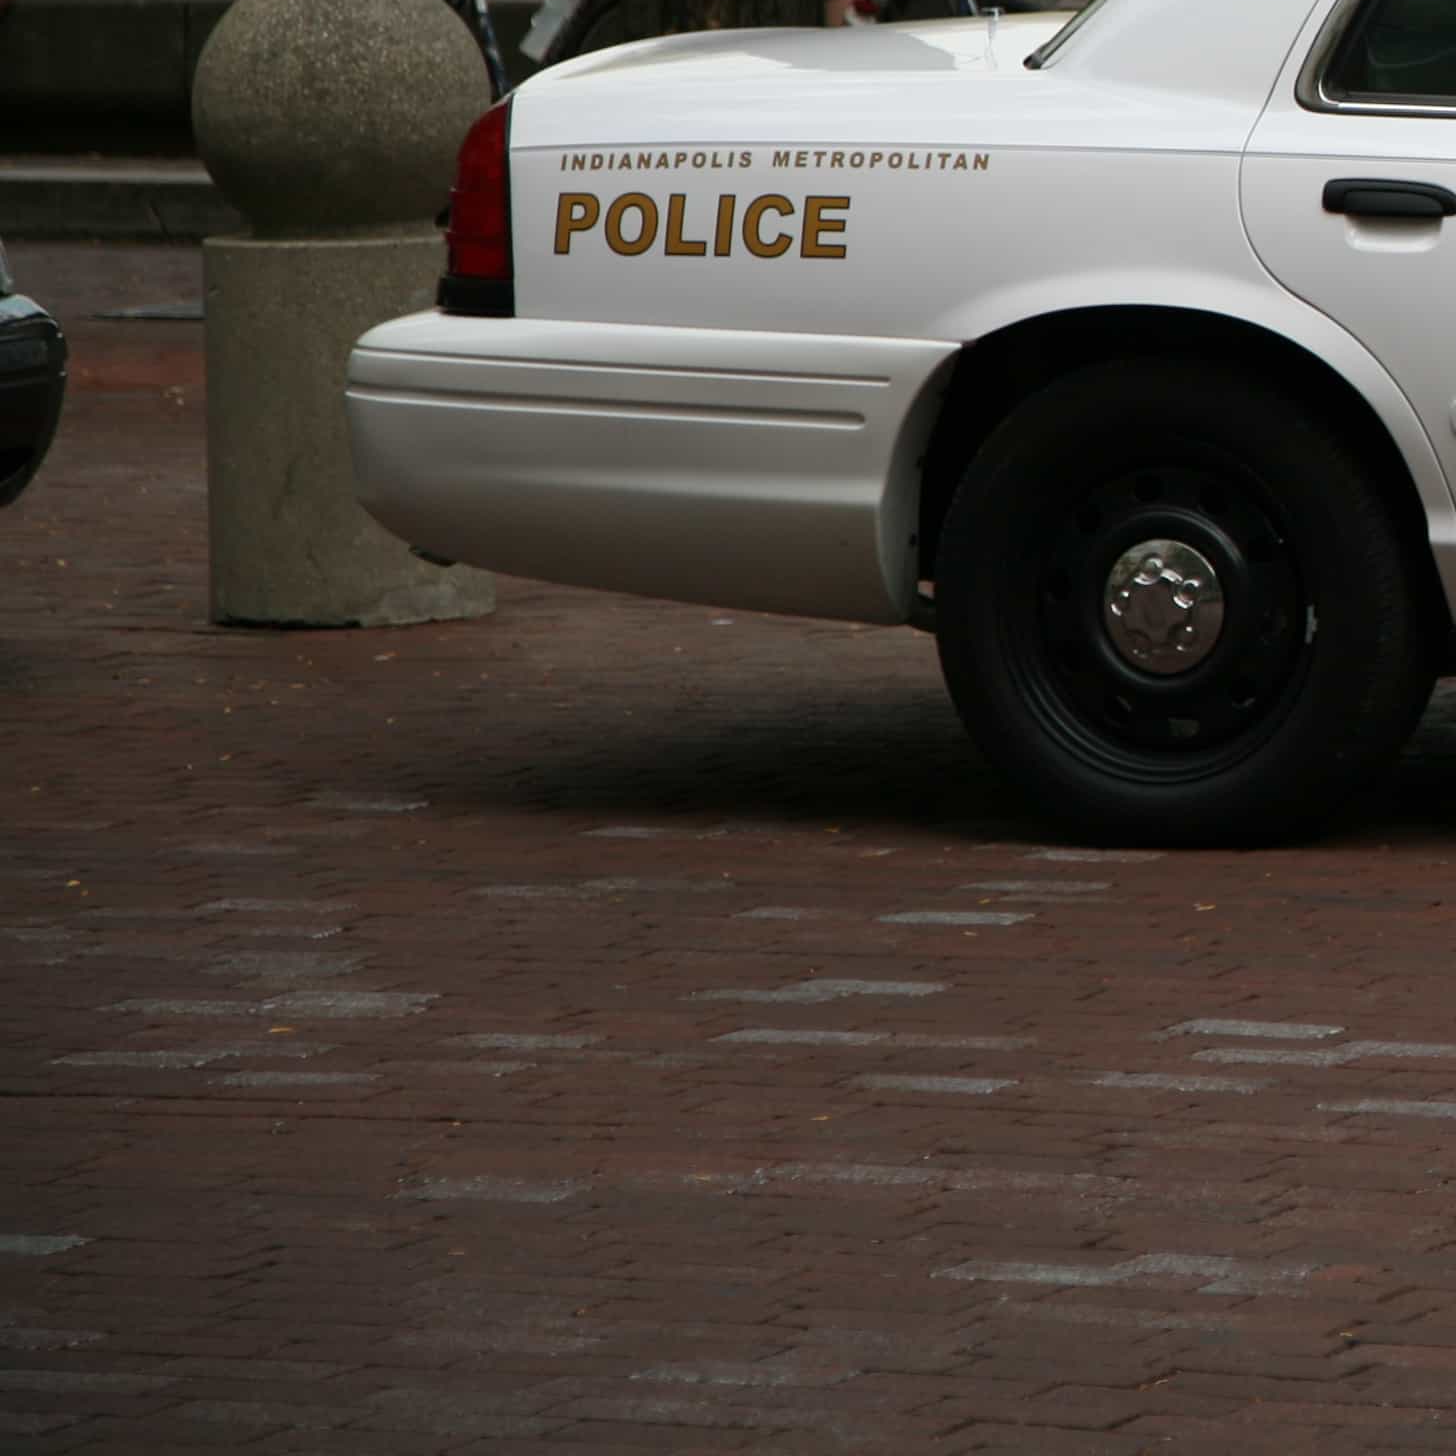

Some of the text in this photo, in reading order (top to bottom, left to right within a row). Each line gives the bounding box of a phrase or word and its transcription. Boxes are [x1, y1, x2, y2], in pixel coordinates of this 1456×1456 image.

[560, 150, 991, 171] INDIANAPOLIS METROPOLITAN
[553, 192, 851, 258] POLICE
